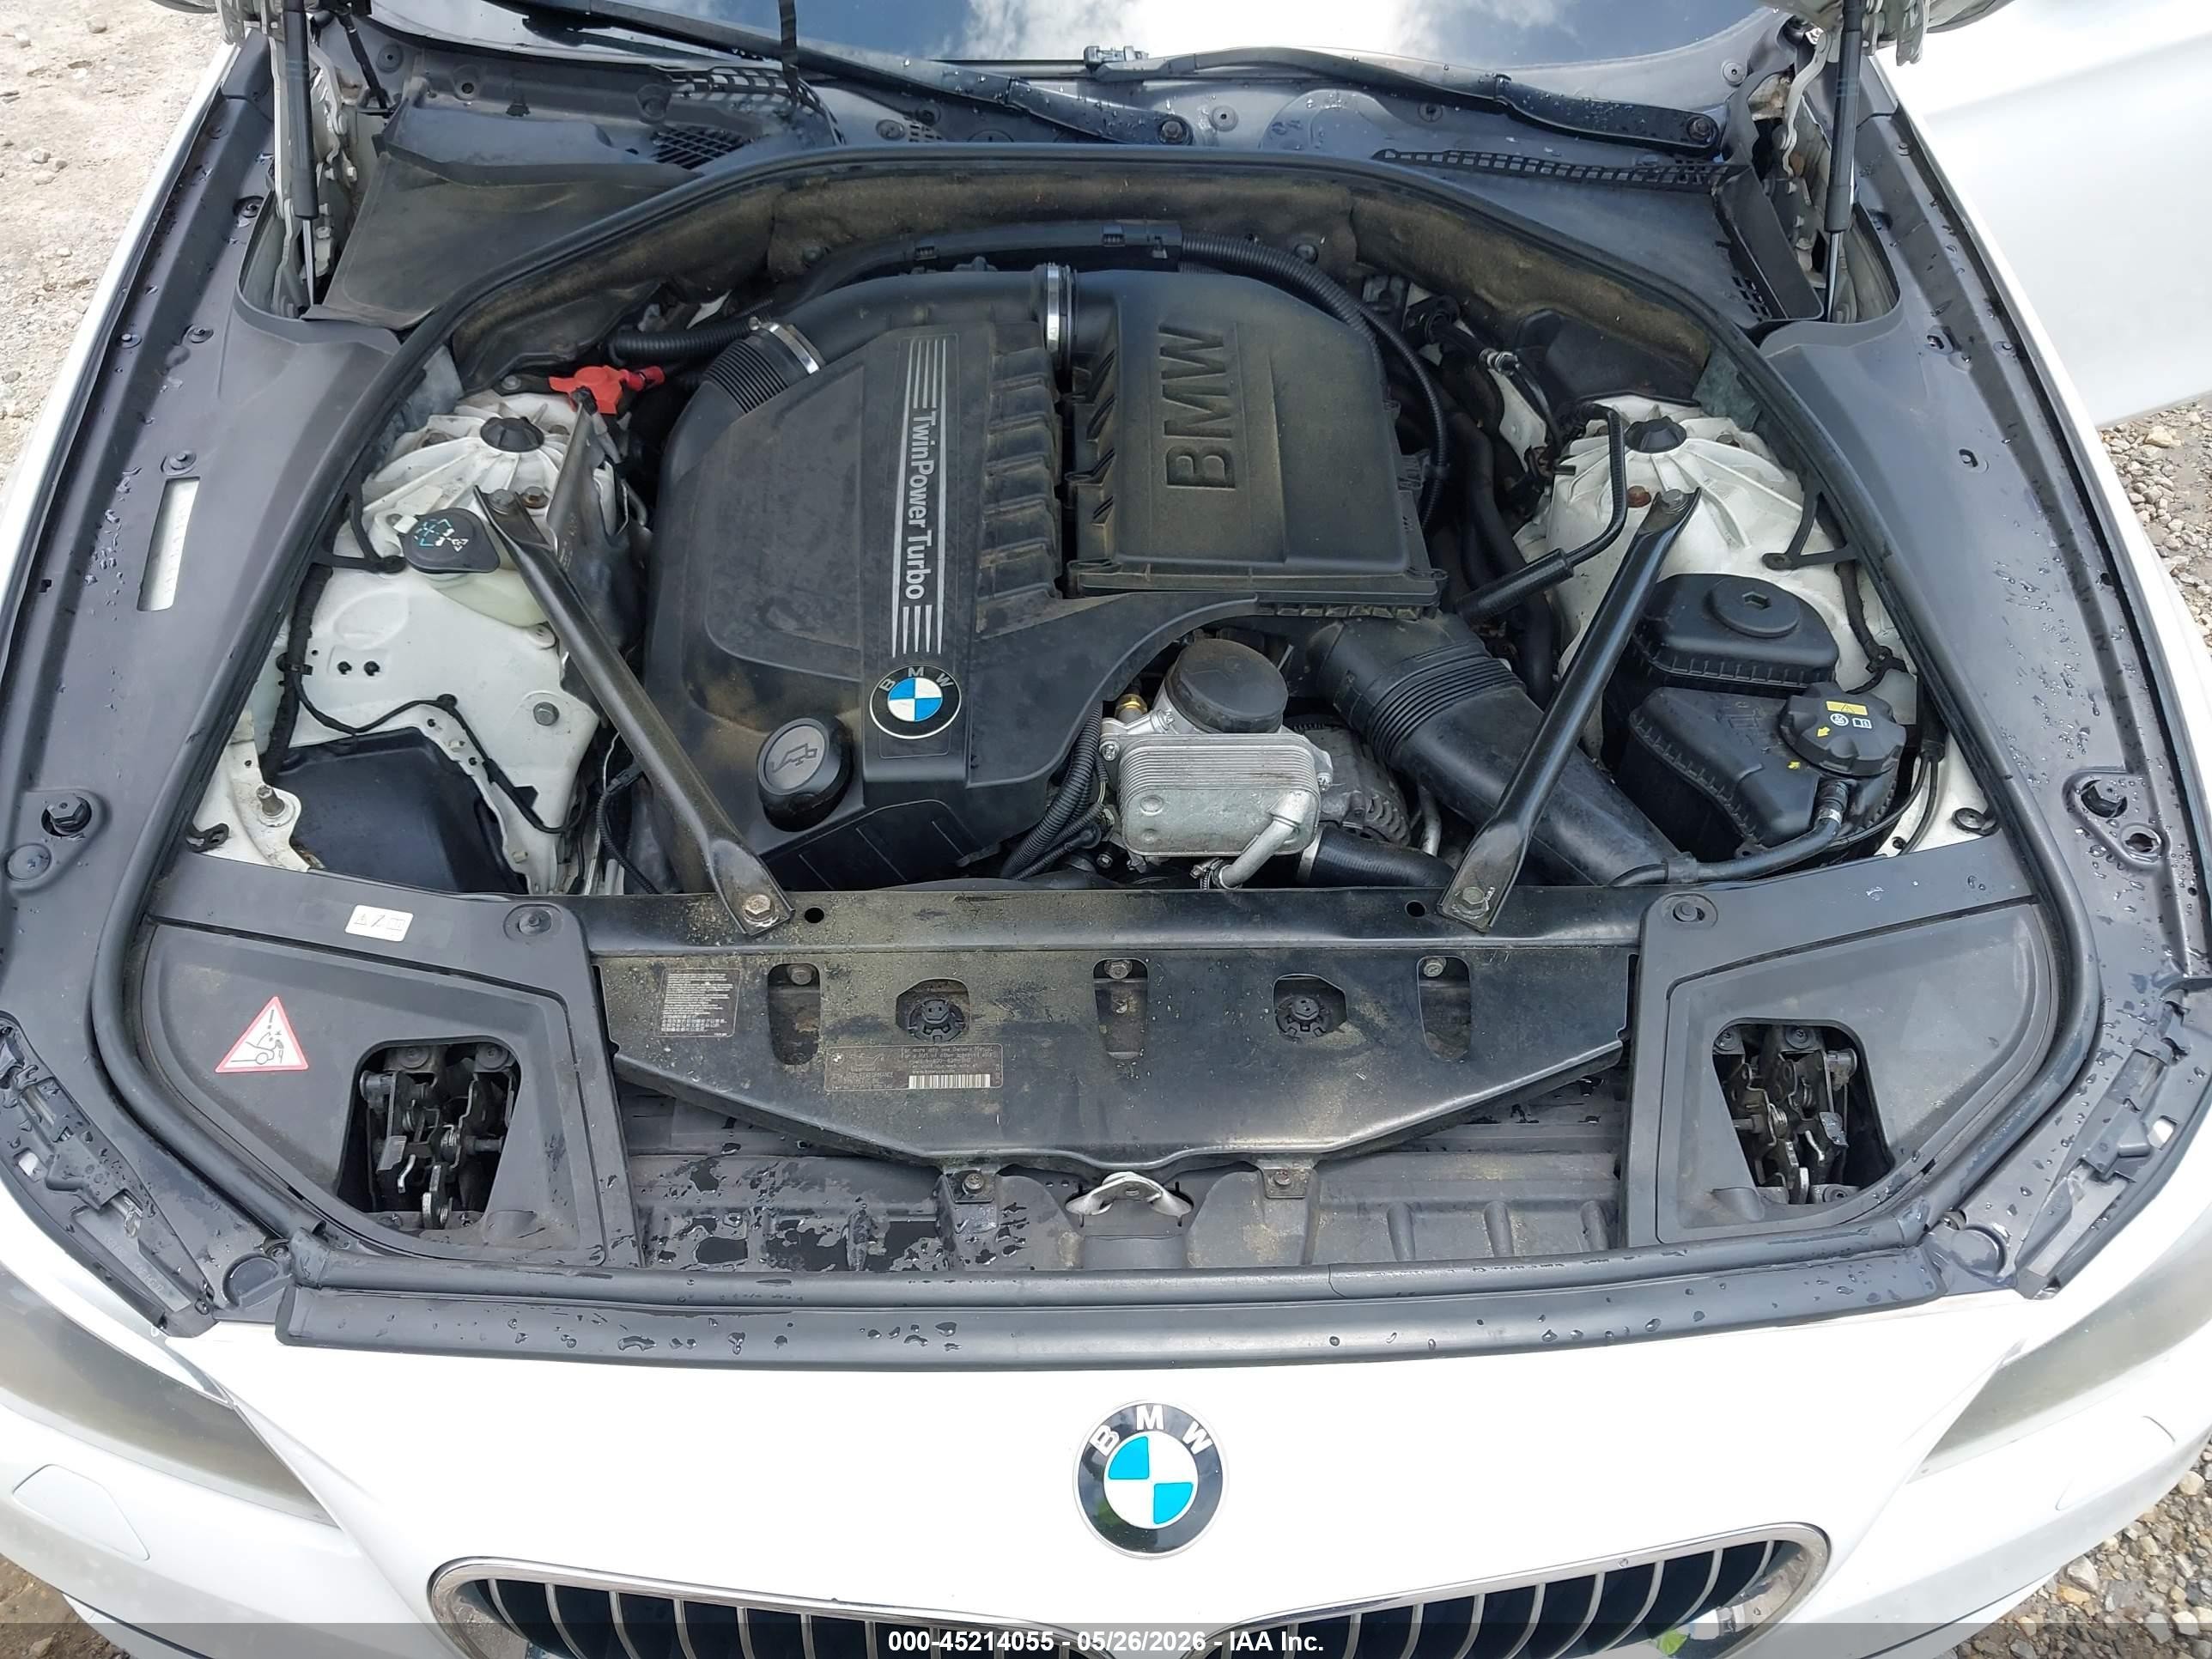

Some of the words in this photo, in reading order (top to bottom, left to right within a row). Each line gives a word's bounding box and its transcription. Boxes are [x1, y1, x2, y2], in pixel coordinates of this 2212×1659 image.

[1158, 325, 1237, 490] BMW
[908, 410, 938, 528] TwinPower
[905, 530, 933, 599] Turbo
[878, 665, 956, 692] BMW
[1089, 1403, 1214, 1457] BMW
